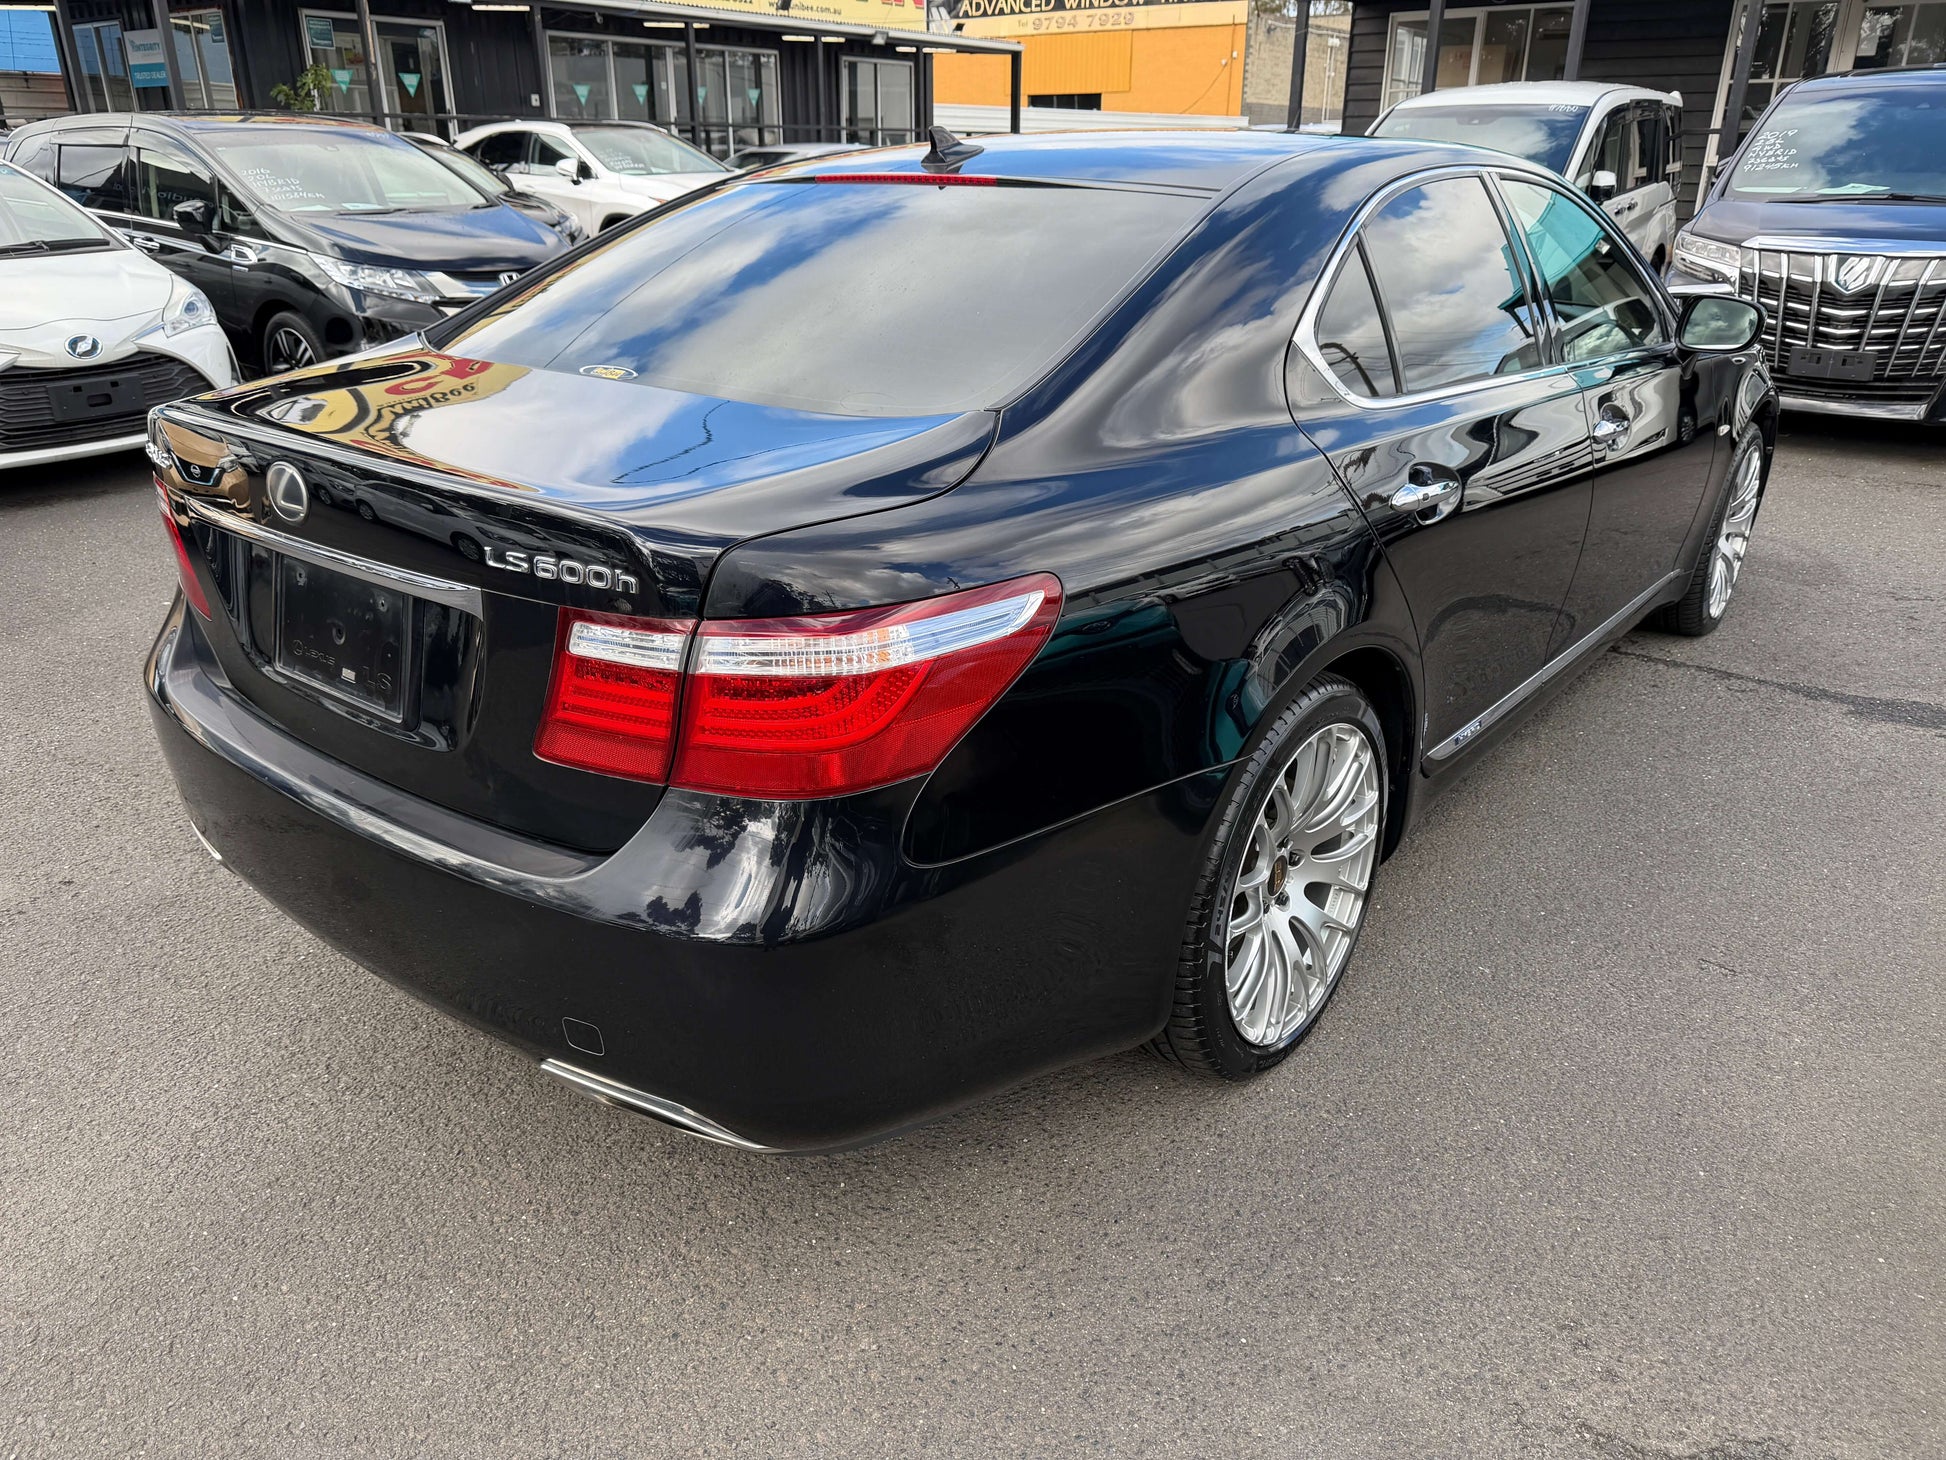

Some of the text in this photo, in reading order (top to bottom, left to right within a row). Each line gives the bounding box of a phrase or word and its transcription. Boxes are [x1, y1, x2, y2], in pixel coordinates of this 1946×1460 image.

[768, 2, 842, 15] wunibee.com.au
[959, 0, 1053, 17] ADVANCED
[1032, 16, 1078, 30] 9794
[1087, 12, 1135, 27] 7929
[1757, 129, 1798, 140] 2019
[1748, 149, 1797, 158] HYBRID
[241, 168, 270, 176] 2016
